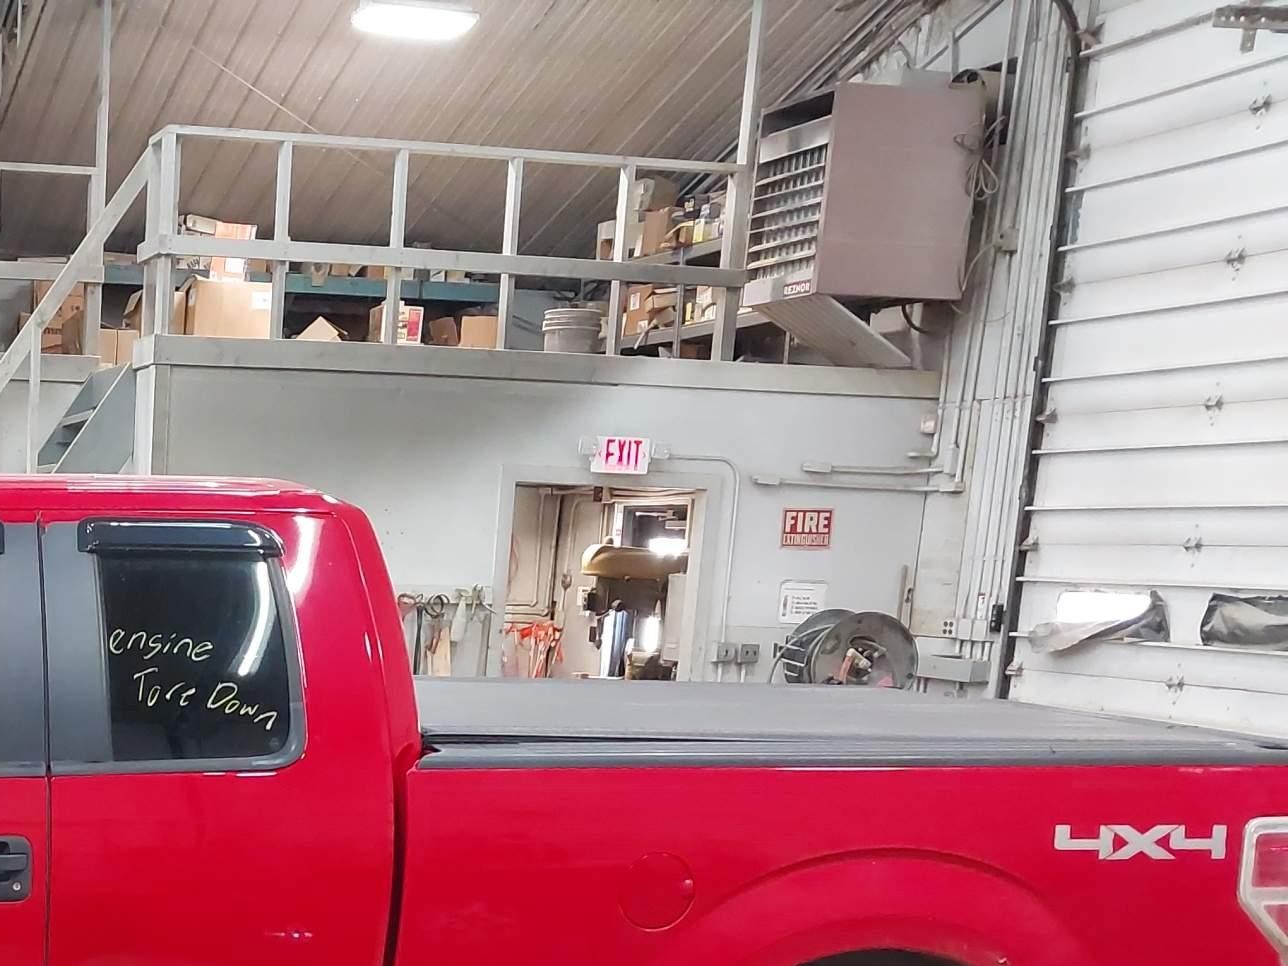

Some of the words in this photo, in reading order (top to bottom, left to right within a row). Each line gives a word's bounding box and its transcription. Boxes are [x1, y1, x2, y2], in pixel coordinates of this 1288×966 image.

[604, 438, 643, 470] EXIT
[784, 511, 831, 533] FIRE
[206, 681, 279, 731] Down
